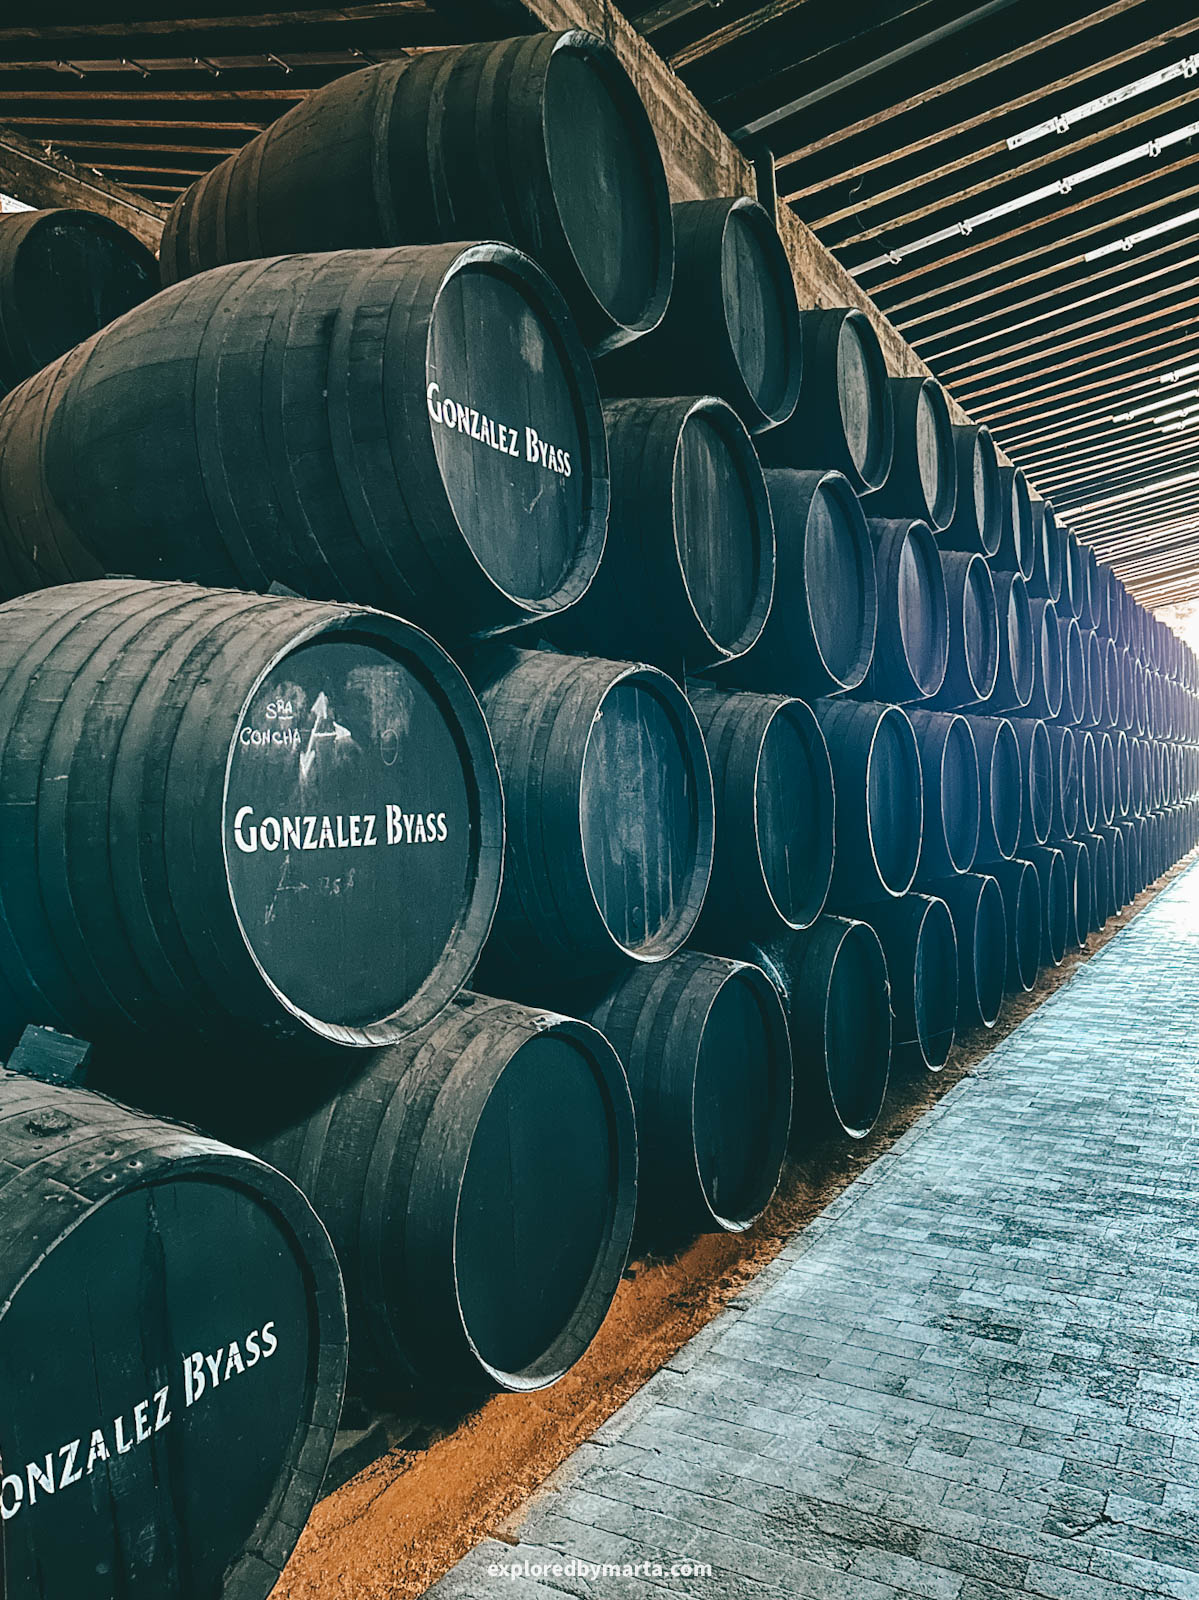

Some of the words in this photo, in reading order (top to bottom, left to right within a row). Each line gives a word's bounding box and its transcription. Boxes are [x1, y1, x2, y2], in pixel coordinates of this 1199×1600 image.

[427, 382, 519, 457] GONZALEZ
[525, 427, 572, 477] BYASS
[240, 727, 301, 748] CONCHA
[235, 806, 376, 853] GONZALEZ
[386, 804, 448, 845] BYASS
[0, 1386, 171, 1520] ONZALEZ
[183, 1321, 278, 1407] BYASS
